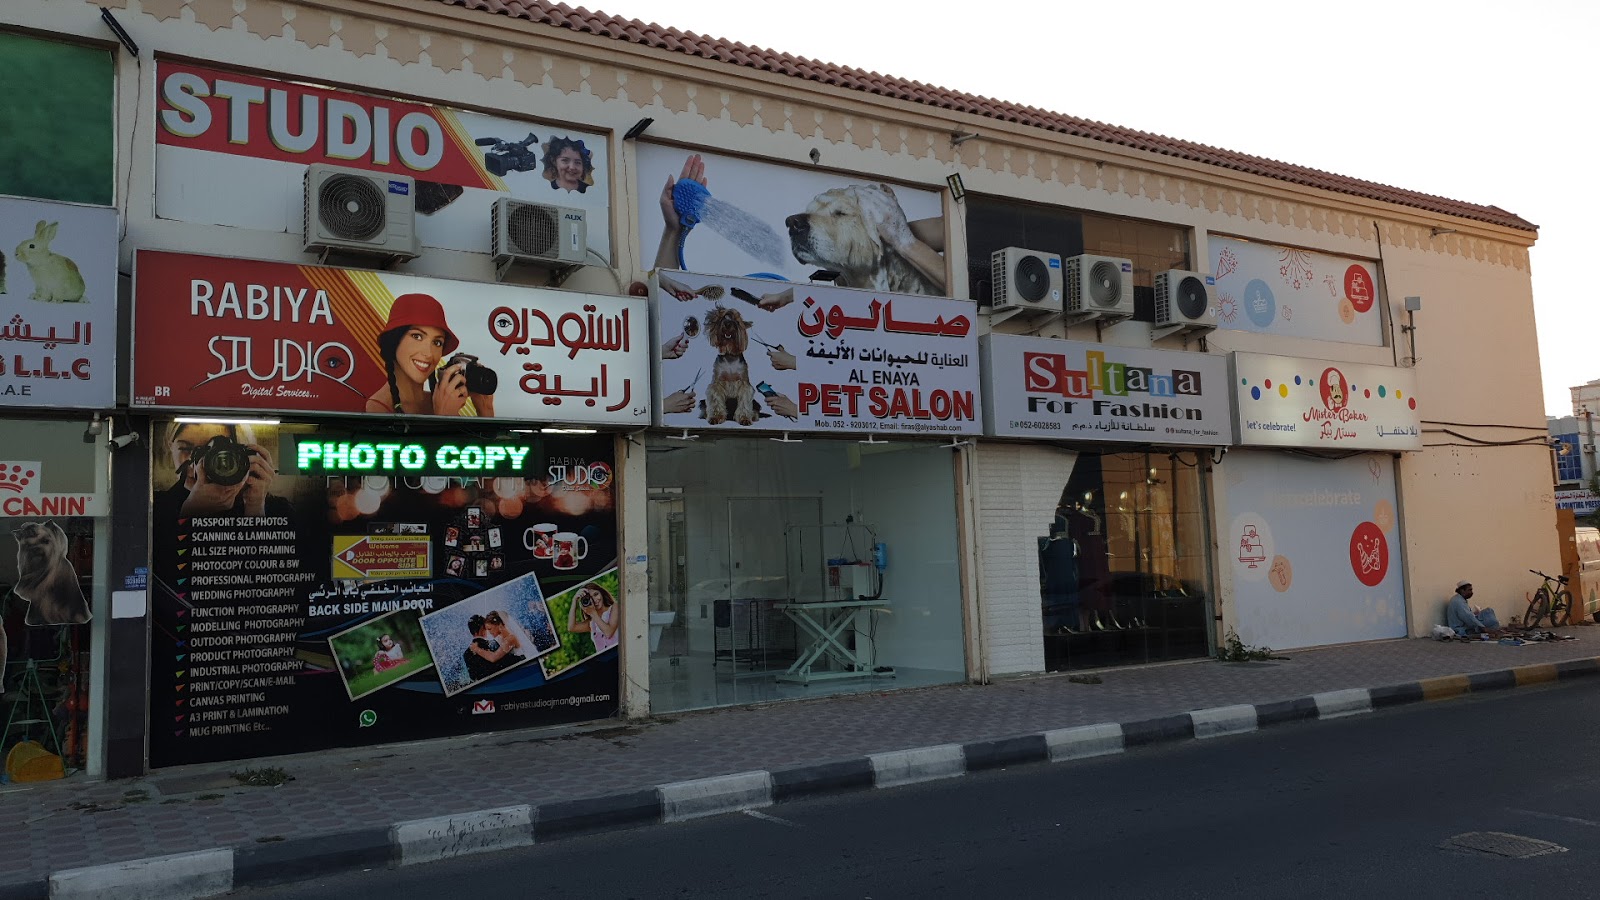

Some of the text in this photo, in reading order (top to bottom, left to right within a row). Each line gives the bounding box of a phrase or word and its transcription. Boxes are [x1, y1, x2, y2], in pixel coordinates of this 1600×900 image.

[159, 72, 445, 173] STUDIO
[564, 213, 583, 222] AUX
[191, 279, 334, 325] RABIYA
[798, 296, 972, 339] صالون
[0, 314, 92, 349] اليش
[488, 304, 630, 360] استوديو
[206, 335, 355, 384] STUDIO
[806, 339, 968, 369] العناية للحيوانات الأليفة
[14, 354, 91, 380] L.L.C
[1027, 354, 1200, 397] Sultana
[849, 369, 920, 386] AL ENAYA
[154, 385, 171, 397] BR
[241, 383, 274, 399] Digital
[519, 362, 631, 412] رابية
[798, 382, 975, 422] PET SALON
[1027, 397, 1202, 421] For Fashion
[814, 419, 832, 428] Mob.
[832, 420, 845, 428] 052
[1303, 407, 1368, 423] Mister Baker
[1246, 420, 1296, 432] let's celebrate!
[297, 441, 530, 470] PHOTO COPY
[549, 456, 586, 466] RABIYA
[548, 465, 608, 485] STUDIO
[3, 496, 85, 516] CANIN
[191, 516, 288, 527] PASSPORT SIZE PHOTOS
[191, 530, 296, 542] SCANNING & LAMINATION
[191, 545, 296, 556] ALL SIZE PHOTO FRAMING
[191, 559, 300, 571] PHOTOCOPY COLOUR & BW
[191, 572, 316, 586] PROFESSIONAL PHOTOGRAPHY
[191, 587, 295, 601] WEDDING PHOTOGRAPHY
[191, 603, 300, 618] FUNCTION PHOTOGRAPHY
[308, 598, 434, 617] BACK SIDE MAIN DOOR
[190, 618, 305, 633] MODELLING PHOTOGRAPHY
[190, 633, 297, 648] OUTDOOR PHOTOGRAPHY
[190, 647, 295, 662] PRODUCT PHOTOGRAPHY
[190, 661, 304, 678] INDUSTRIAL PHOTOGRAPHY
[190, 675, 296, 692] PRINT/COPY/SCAN/E-MAIL
[189, 692, 266, 707] CANVAS PRINTING
[189, 705, 289, 722] A3 PRINT & LAMINATION
[189, 726, 210, 737] MUG
[211, 723, 252, 735] PRINTING
